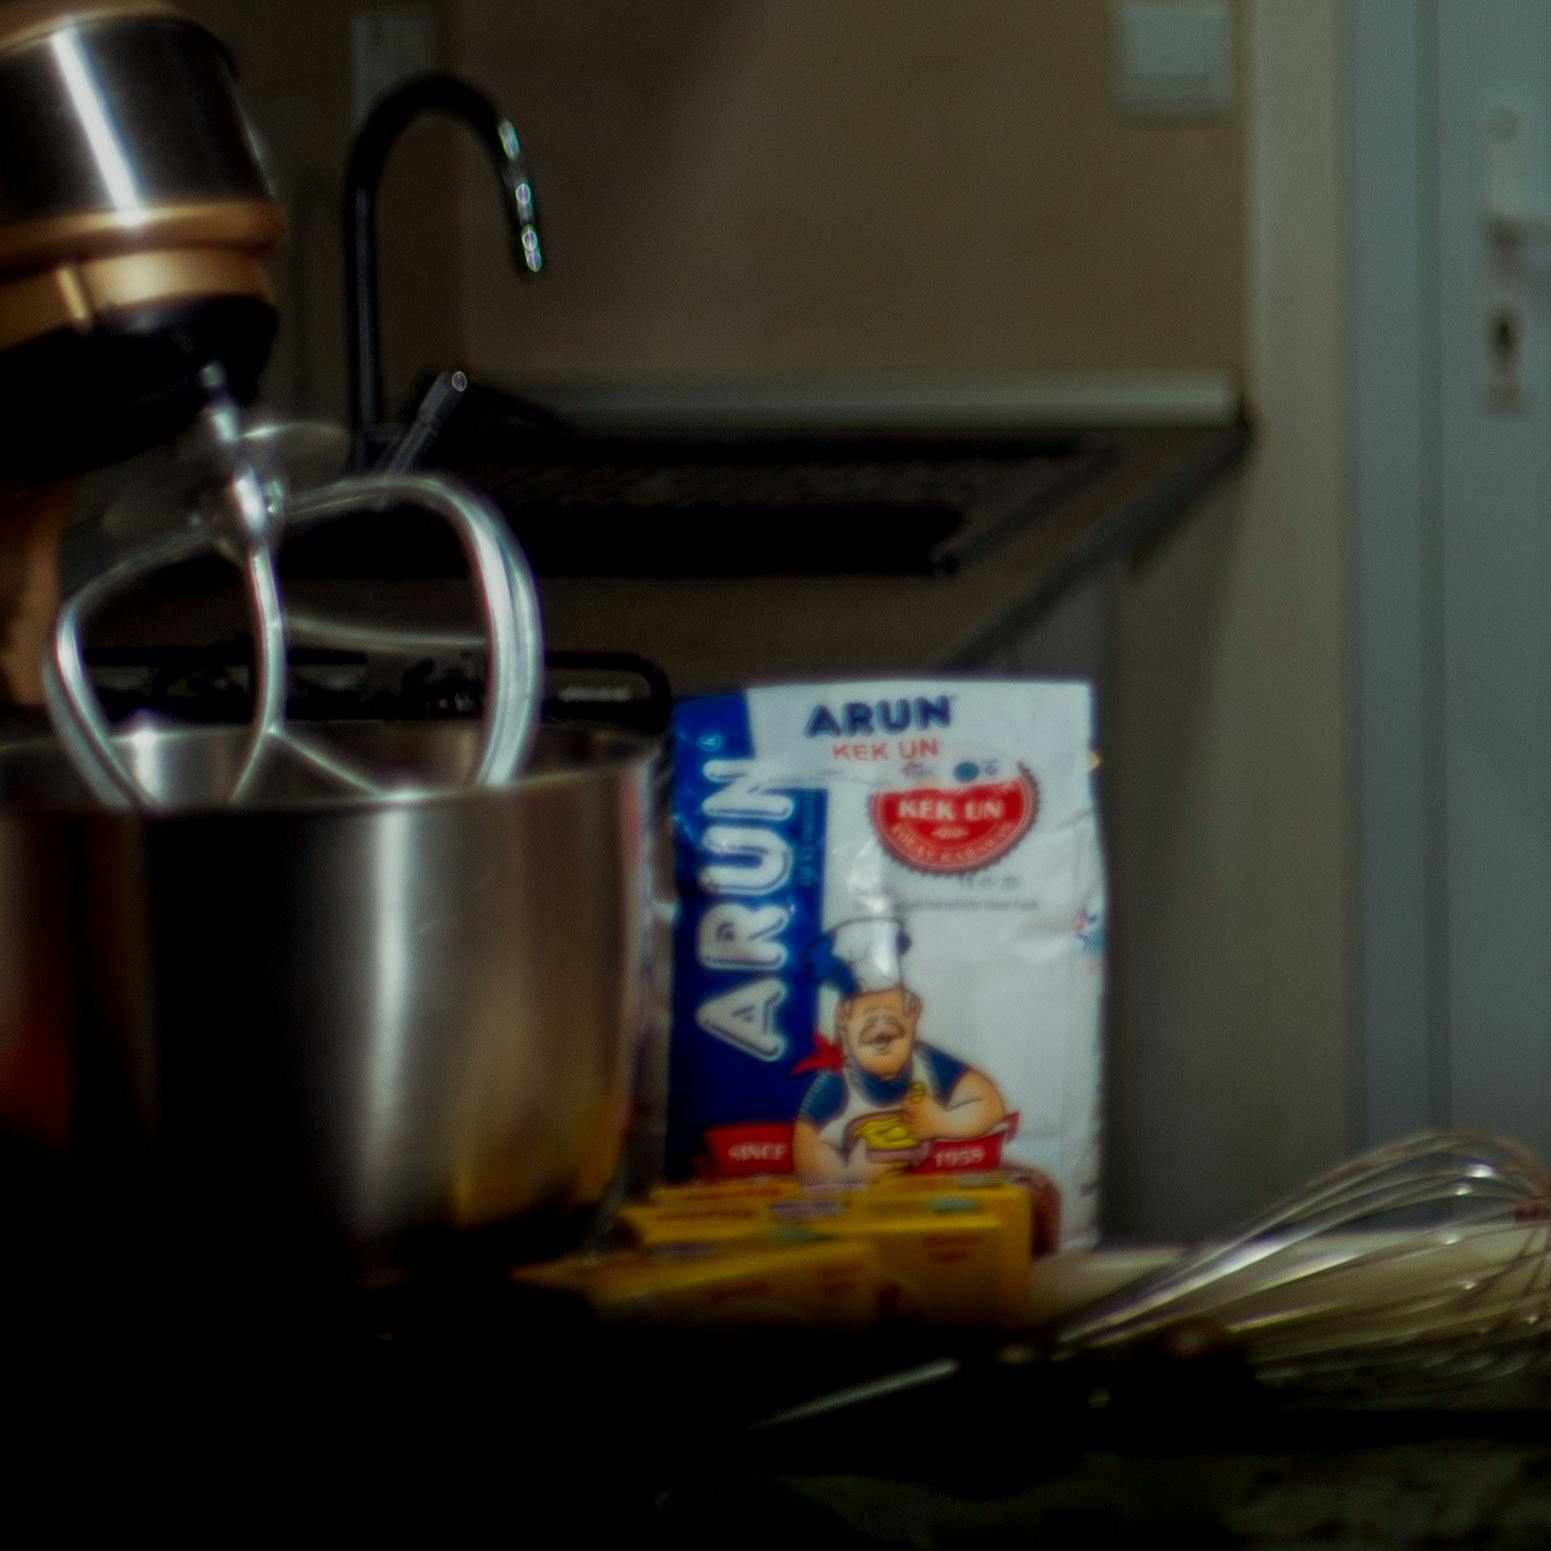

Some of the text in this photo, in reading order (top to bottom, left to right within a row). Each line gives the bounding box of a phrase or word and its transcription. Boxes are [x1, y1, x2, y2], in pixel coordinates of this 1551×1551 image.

[803, 694, 953, 738] ARUN
[832, 736, 941, 762] KEK UN
[897, 799, 1005, 822] KEK UN
[695, 758, 795, 1063] ARUN
[727, 1141, 788, 1163] SINCE
